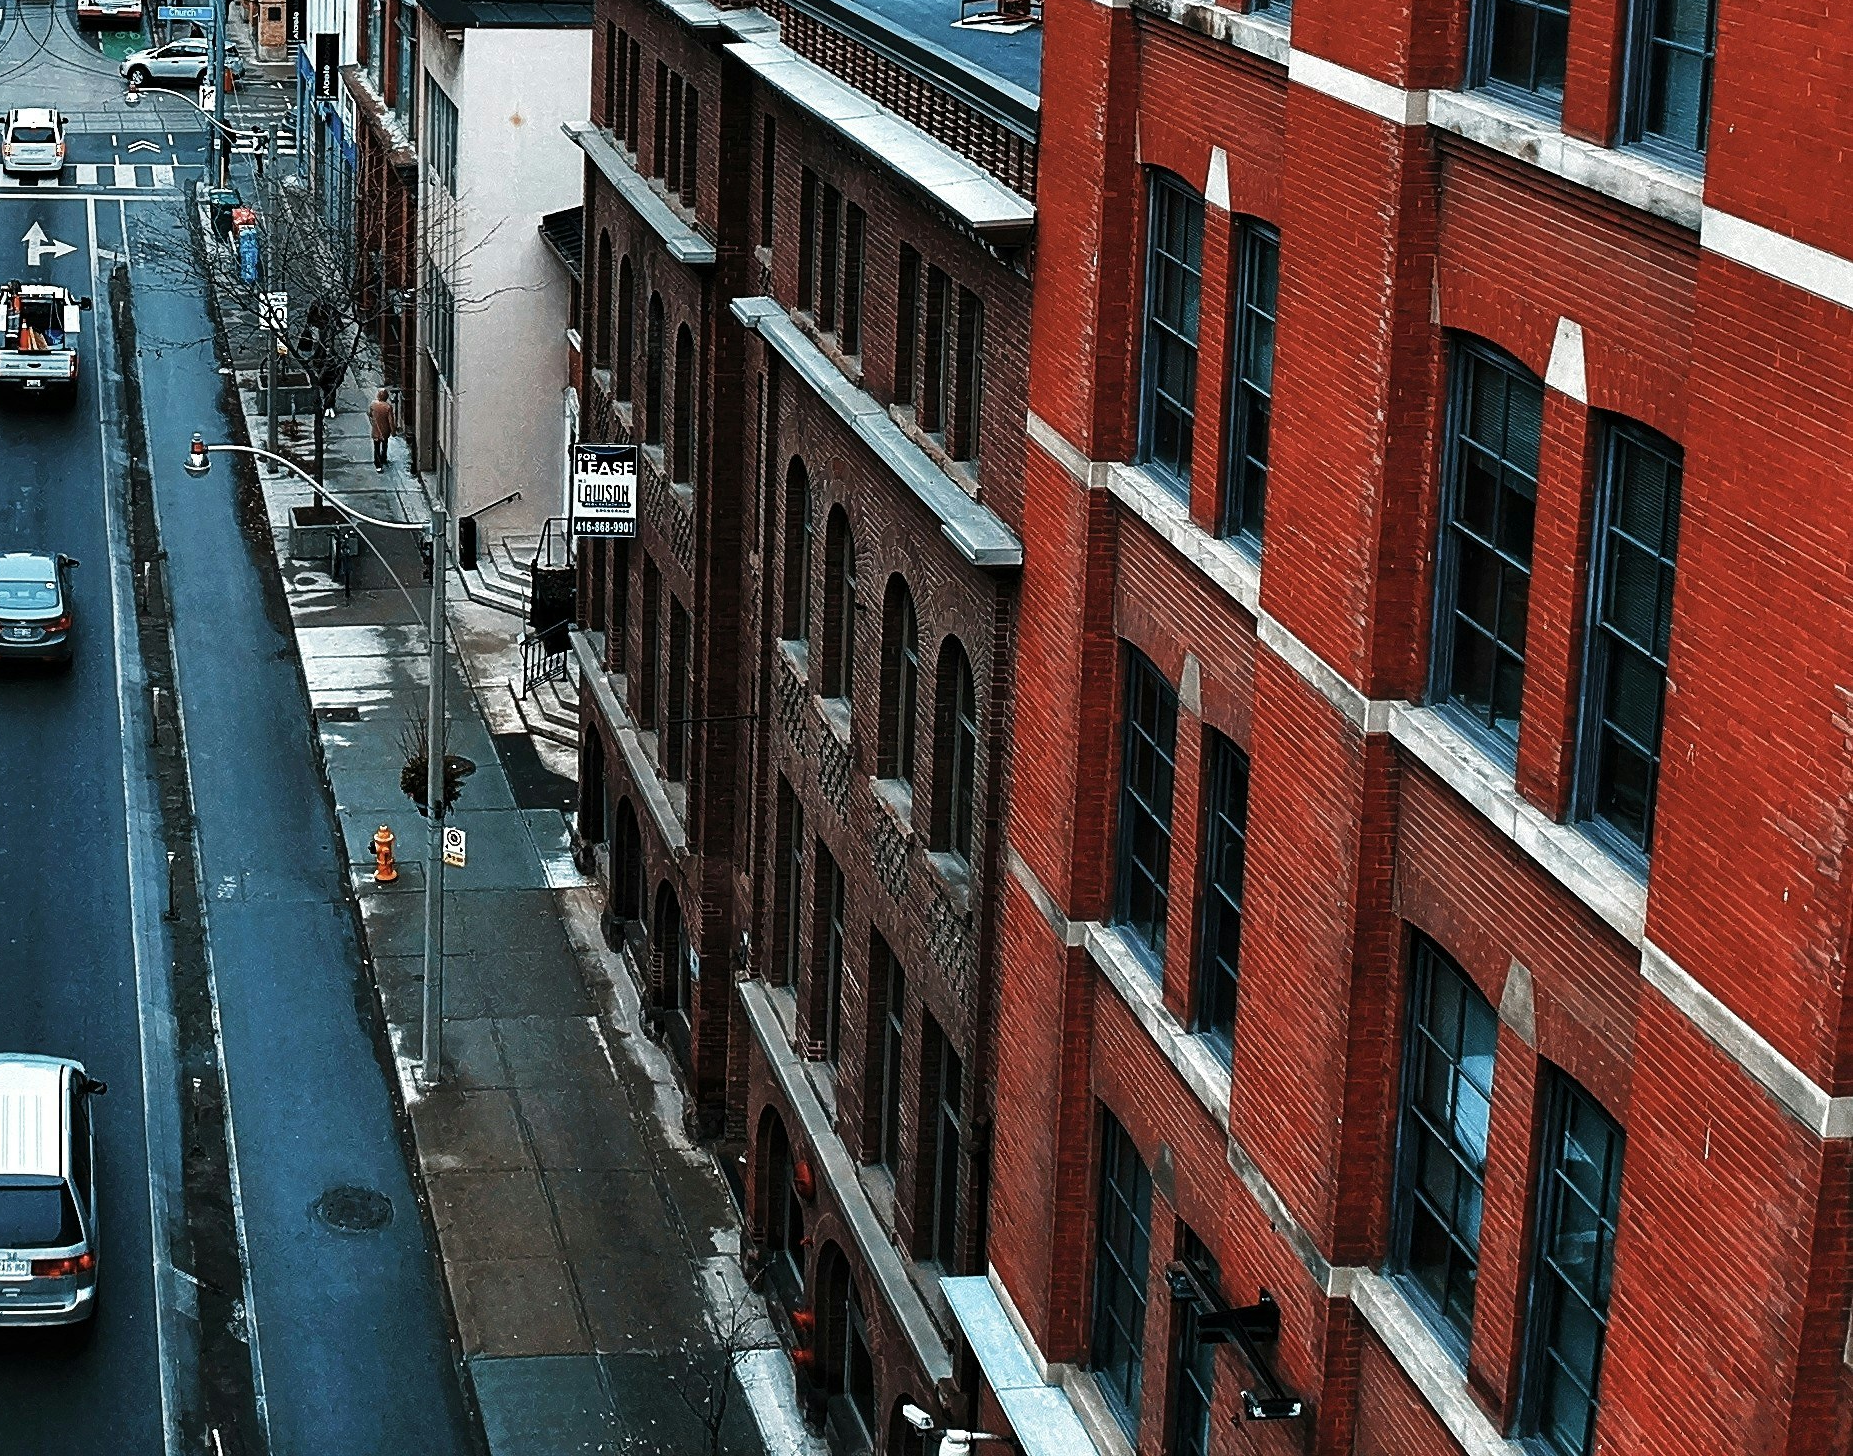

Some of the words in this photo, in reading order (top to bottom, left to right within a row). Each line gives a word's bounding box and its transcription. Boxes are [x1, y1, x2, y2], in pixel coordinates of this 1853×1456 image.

[168, 7, 197, 17] Church
[577, 453, 597, 461] FOR
[577, 460, 634, 476] LEASE
[577, 484, 629, 503] LAWSON
[575, 521, 634, 533] 416-868-9901
